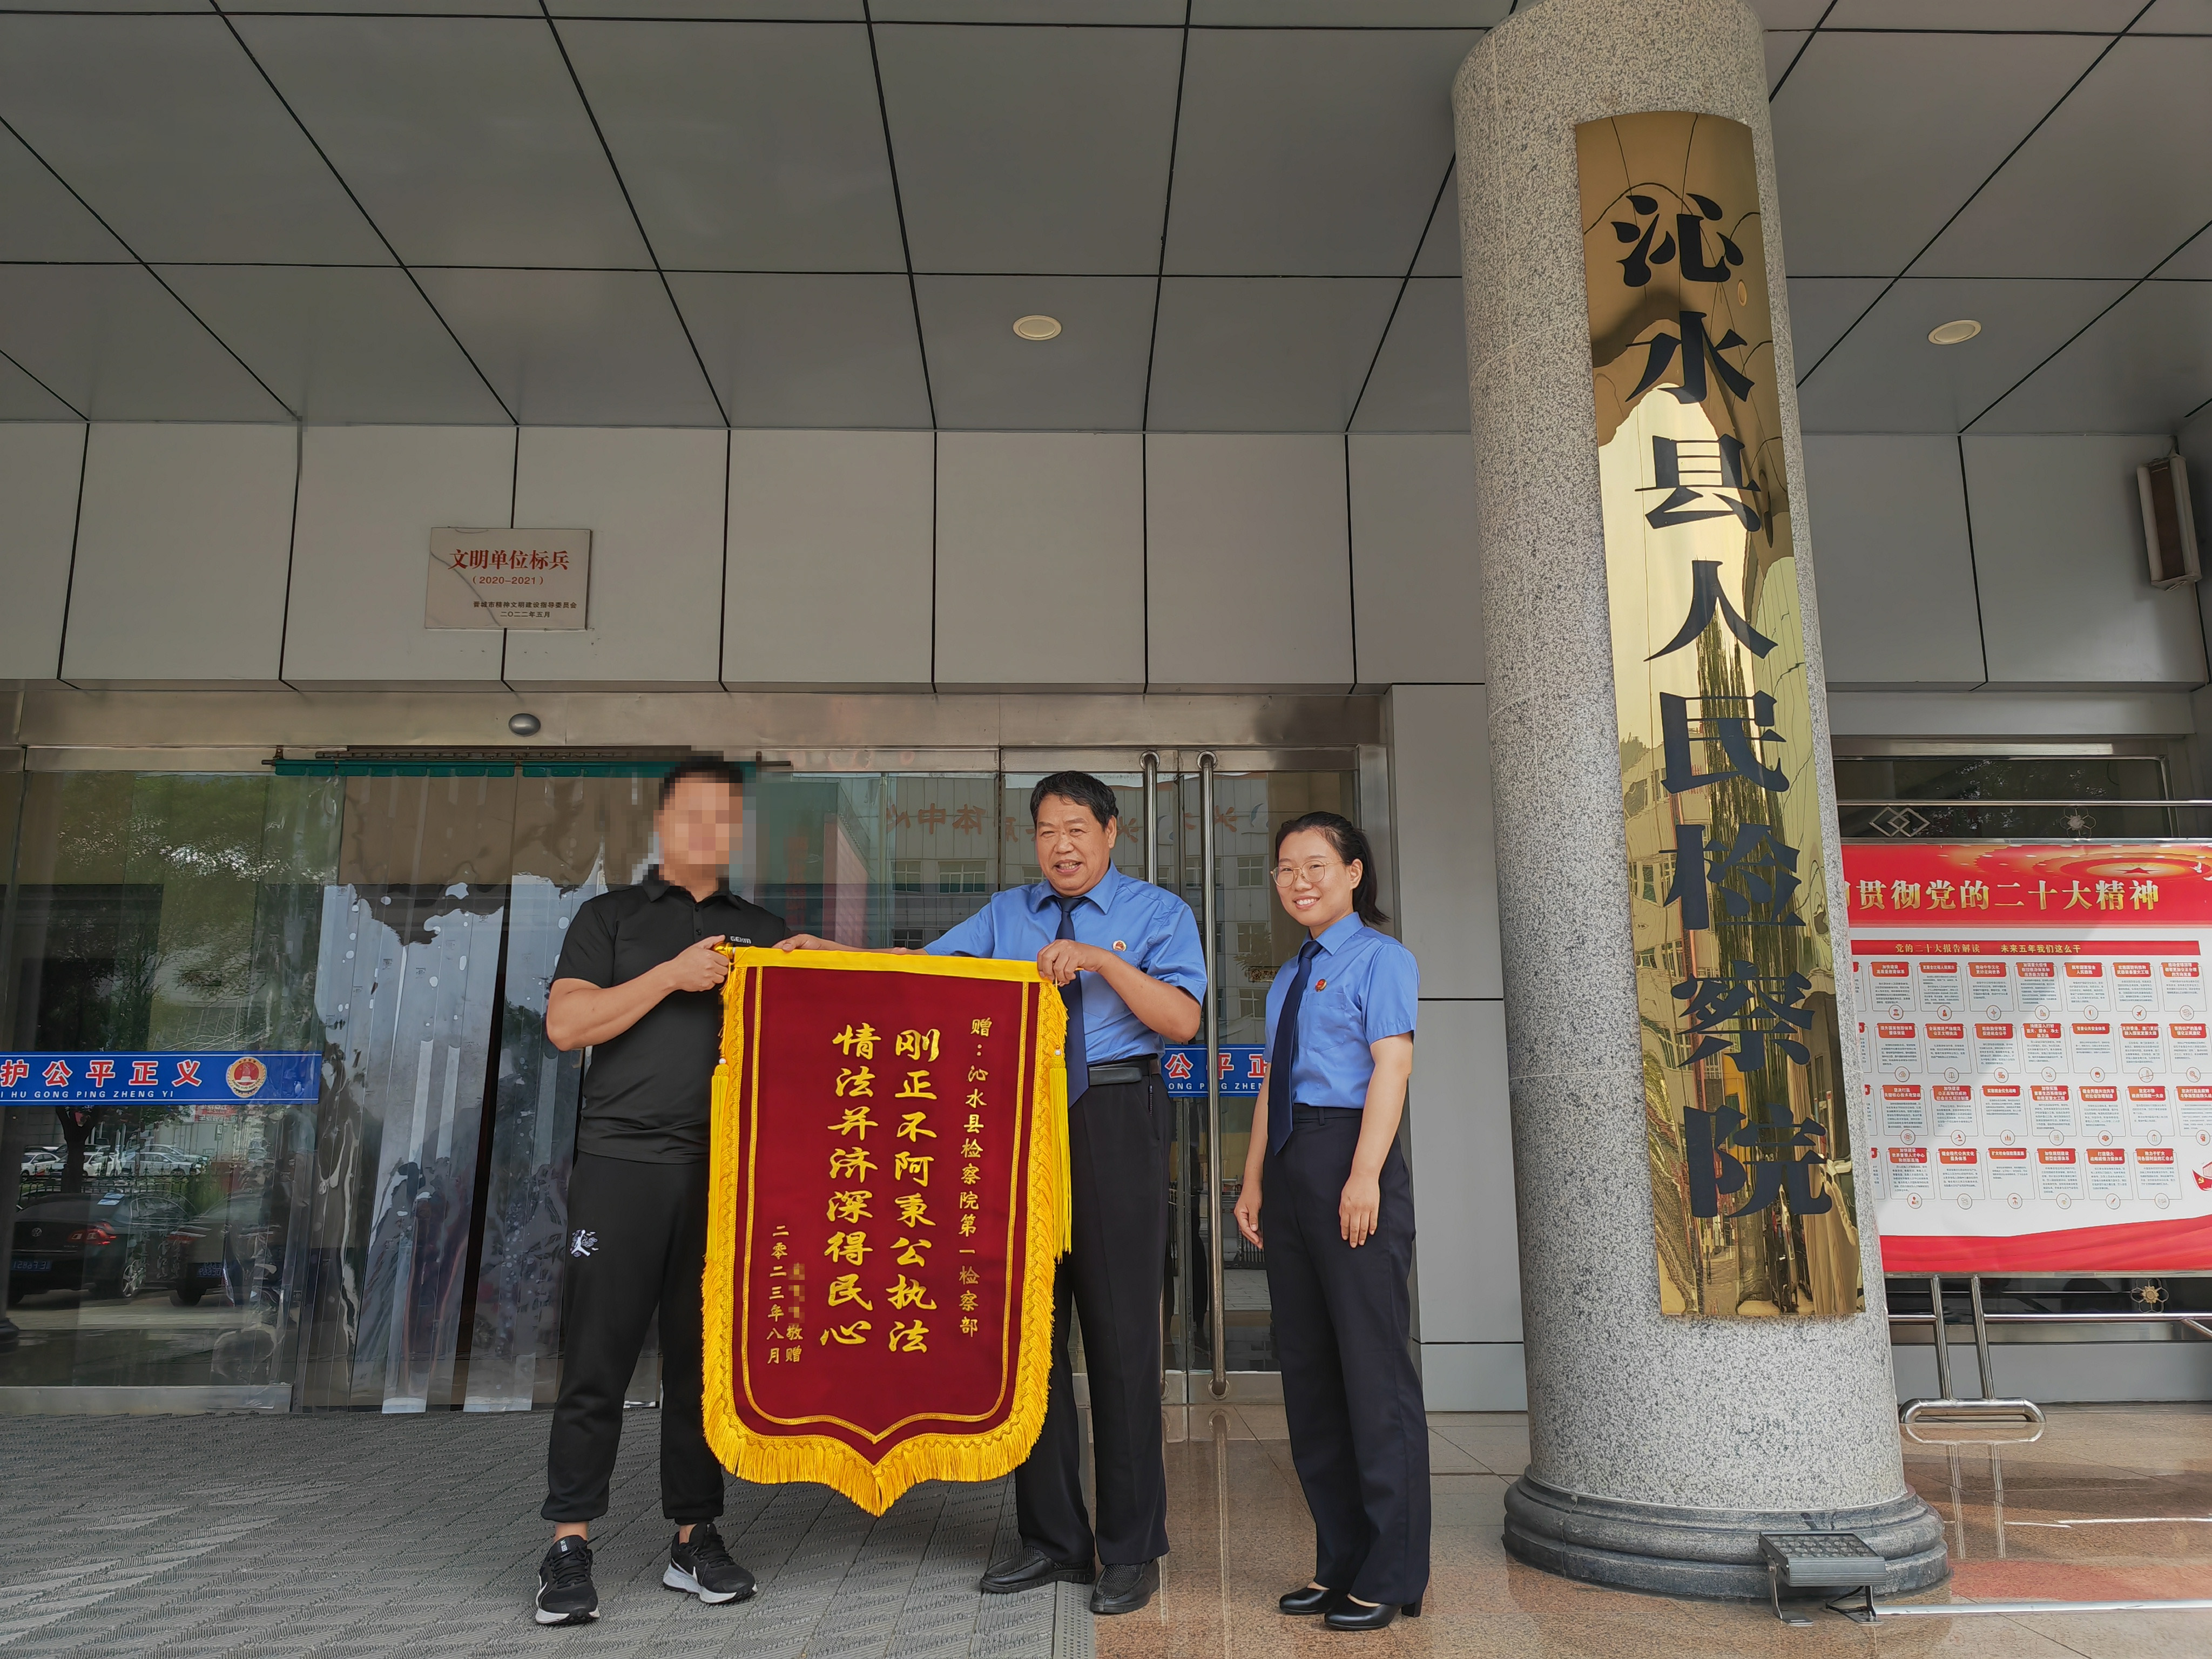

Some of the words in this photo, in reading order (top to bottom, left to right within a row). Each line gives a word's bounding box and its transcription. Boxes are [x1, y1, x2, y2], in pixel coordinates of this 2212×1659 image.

[448, 549, 570, 570] 文明单位标兵
[473, 601, 577, 609] 晋城市精神文明建设指导委员会
[1611, 193, 1832, 1218] 沁水县人民检察院
[1895, 942, 1981, 954] 党的二十大报告解读
[2000, 943, 2081, 954] 未来五年我们这么干
[1, 1060, 201, 1088] 护公平正义
[820, 1022, 882, 1346] 情法并济深得民心
[886, 1028, 941, 1353] 刚正不阿秉公执法
[958, 1017, 993, 1338] 赠：沁水县检察院第一检察部
[766, 1225, 790, 1365] 二零二三年八月
